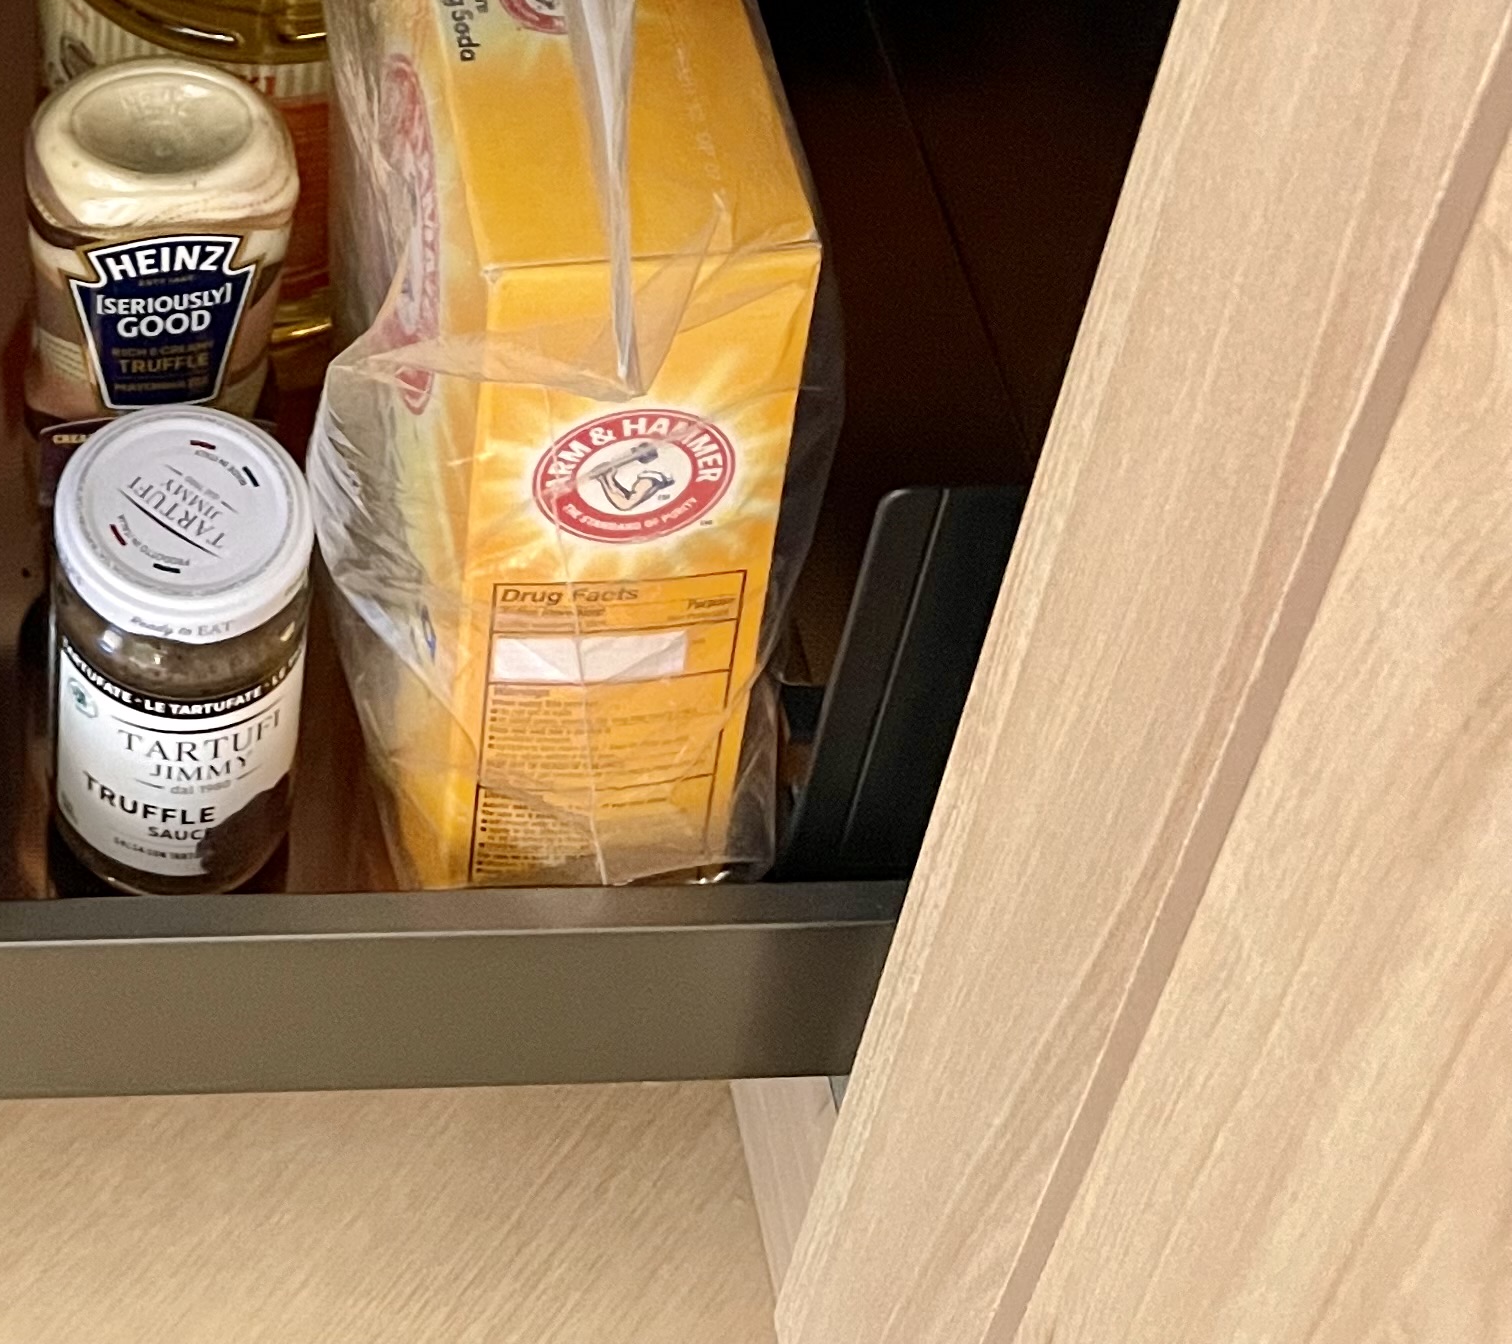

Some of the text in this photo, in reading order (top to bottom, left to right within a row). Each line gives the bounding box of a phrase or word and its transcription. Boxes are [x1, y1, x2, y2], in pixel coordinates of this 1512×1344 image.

[453, 8, 480, 63] Soda
[105, 245, 225, 281] HEINZ
[116, 309, 211, 338] GOOD
[119, 352, 209, 374] TRUFFLE
[589, 427, 617, 446] &
[127, 476, 226, 549] TARTUFI
[161, 478, 223, 520] JIMMY
[501, 586, 640, 606] Drug Facts
[198, 621, 234, 637] EAT
[144, 701, 166, 714] LE
[170, 687, 263, 715] TARTUFATE
[117, 708, 280, 763] TARTUFI
[149, 755, 249, 783] JIMMY
[83, 770, 216, 825] TRUFFLE
